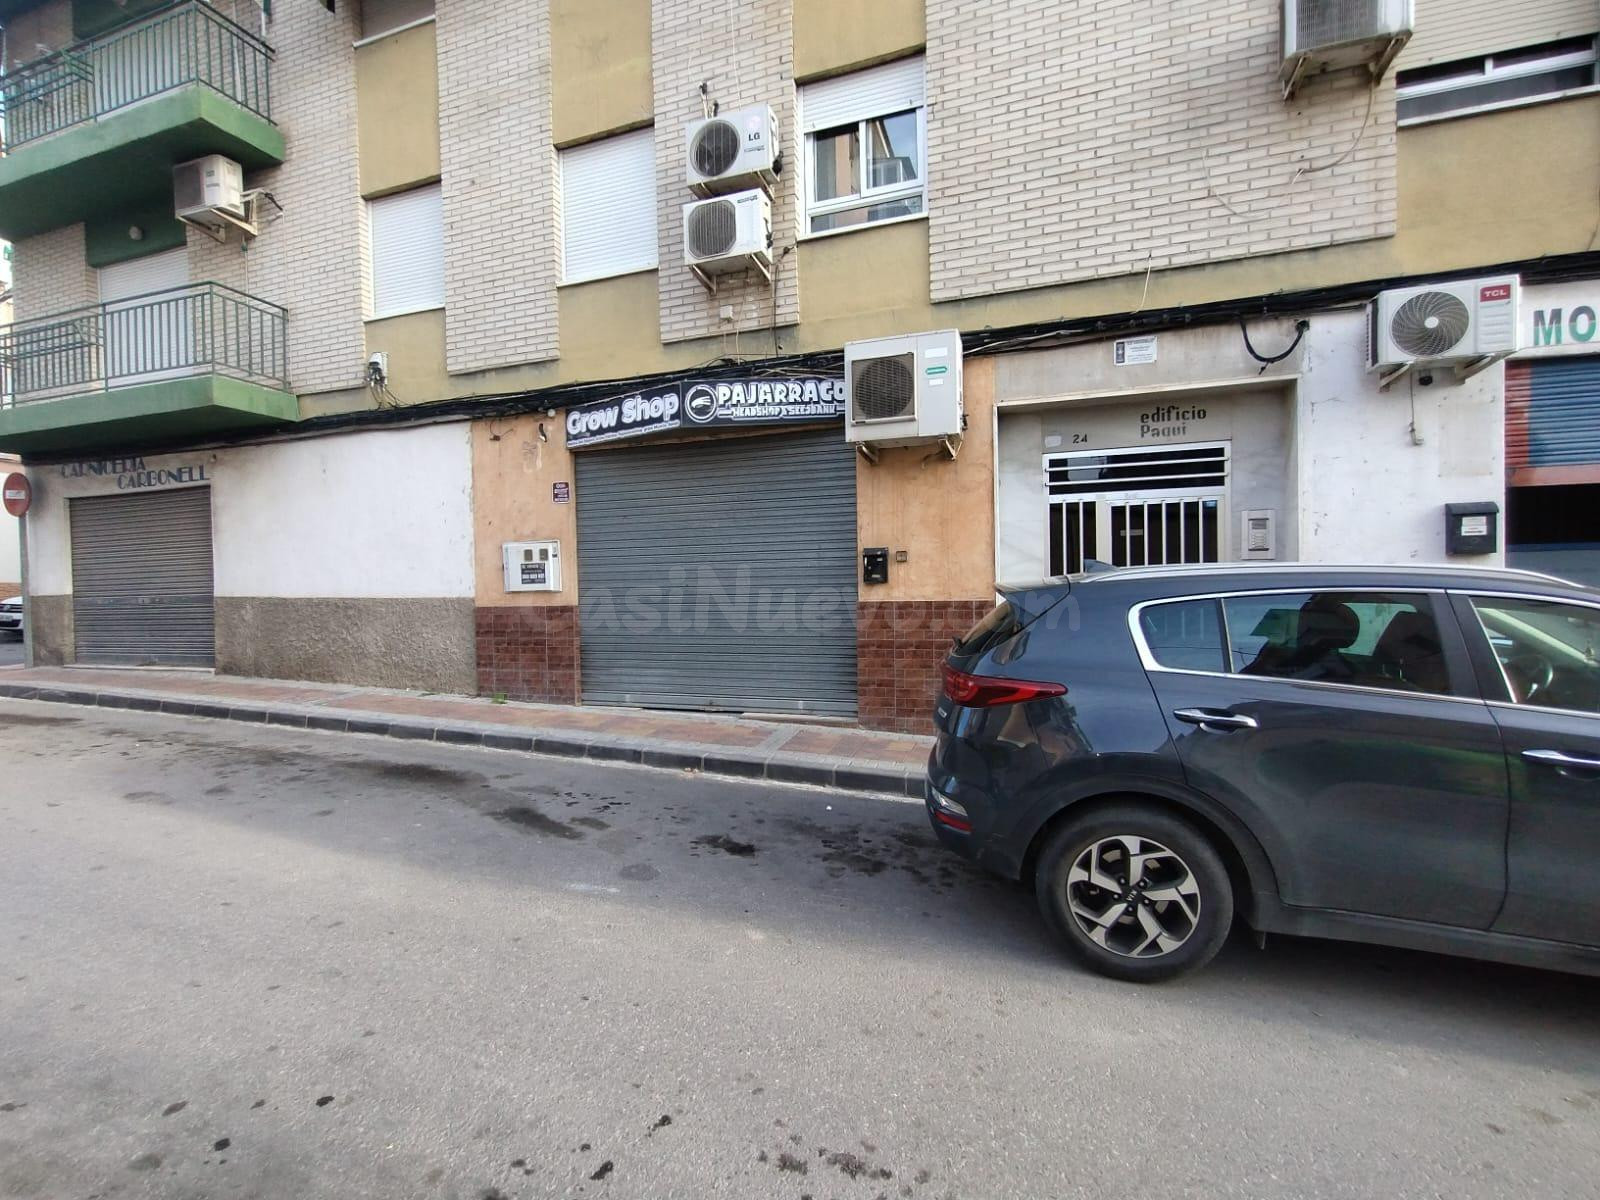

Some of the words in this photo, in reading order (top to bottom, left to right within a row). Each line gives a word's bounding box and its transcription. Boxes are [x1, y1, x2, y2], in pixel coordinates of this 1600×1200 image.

[748, 132, 761, 142] LG
[1484, 288, 1508, 298] TCL
[1532, 304, 1597, 346] MO
[567, 406, 620, 435] Grow
[621, 393, 680, 424] Shop
[1140, 405, 1207, 424] edificio
[1072, 434, 1088, 444] 24
[117, 464, 210, 489] CARBONELL
